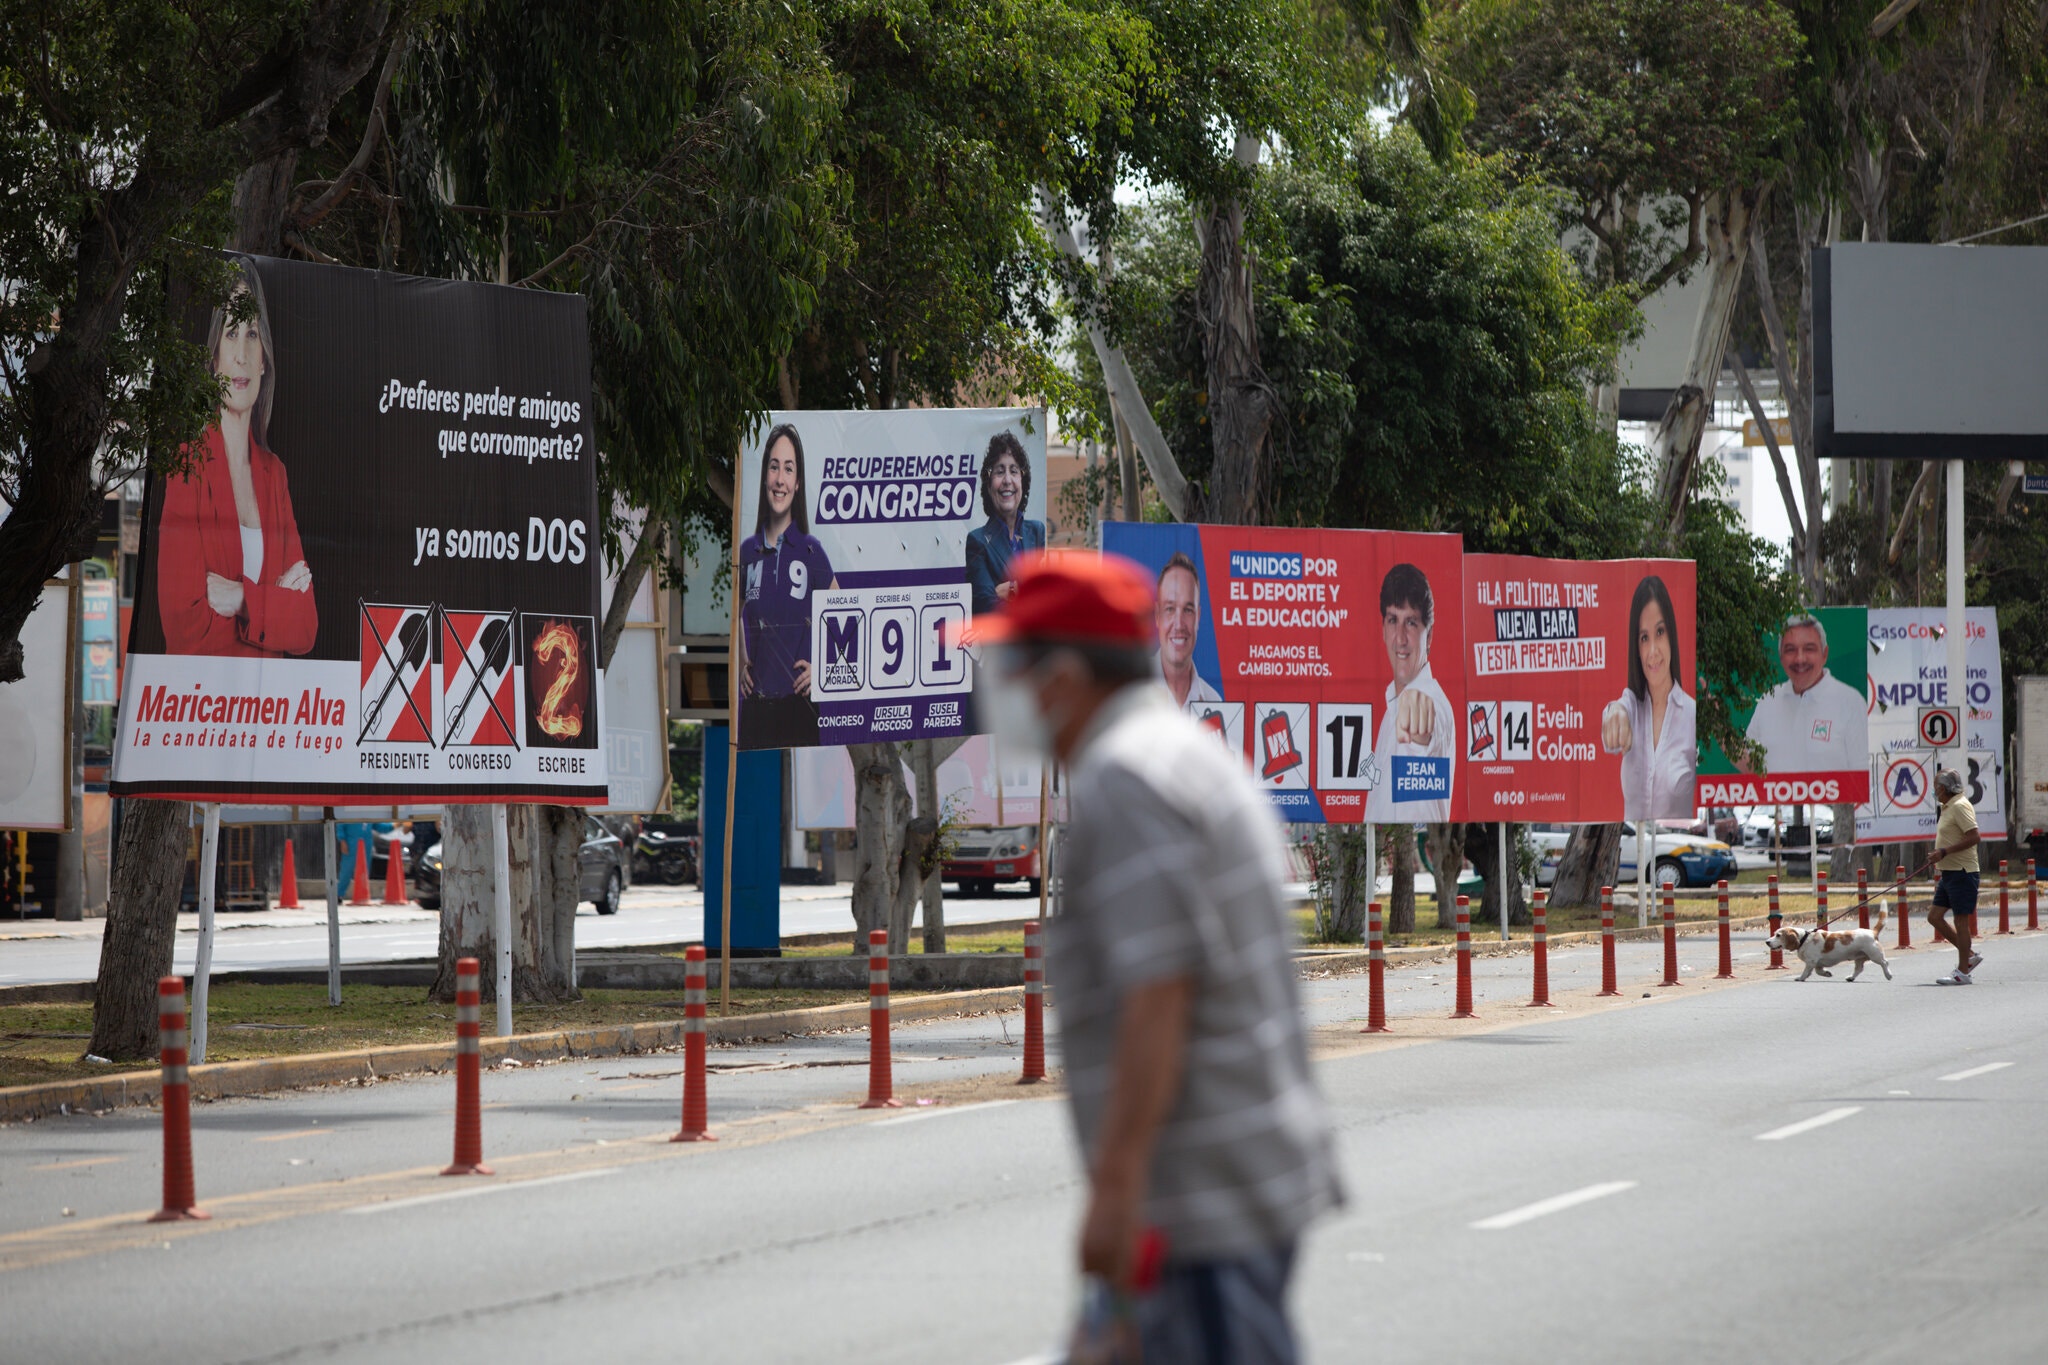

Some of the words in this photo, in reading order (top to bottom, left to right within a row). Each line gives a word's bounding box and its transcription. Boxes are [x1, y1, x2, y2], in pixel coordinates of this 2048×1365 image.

[379, 379, 460, 413] ¿Prefieres
[463, 386, 516, 421] perder
[519, 392, 581, 428] amigos
[438, 429, 467, 459] que
[470, 432, 583, 465] corromperte?
[823, 455, 954, 479] RECUPEREMOS
[958, 454, 978, 476] EL
[819, 481, 973, 520] CONGRESO
[413, 527, 440, 567] ya
[445, 529, 520, 560] somos
[526, 517, 586, 564] DOS
[1232, 555, 1300, 576] “UNIDOS
[1304, 558, 1338, 577] POR
[789, 560, 808, 600] 9
[827, 597, 847, 605] MARCA
[849, 595, 859, 604] ASÍ
[876, 594, 900, 603] ESCRIBE
[901, 592, 911, 602] ASÍ
[926, 592, 949, 601] ESCRIBE
[950, 590, 960, 600] ASÍ
[1230, 581, 1249, 600] EL
[1252, 582, 1326, 602] DEPORTE
[1329, 584, 1340, 602] Y
[1505, 578, 1560, 608] POLÍTICA
[1564, 583, 1599, 608] TIENE
[1222, 607, 1243, 626] LA
[1497, 611, 1537, 639] NUEVA
[1540, 610, 1577, 637] CARA
[827, 616, 858, 664] M
[882, 619, 904, 675] 9
[932, 617, 951, 671] 1
[1249, 645, 1305, 659] HAGAMOS
[1308, 646, 1322, 659] EL
[1477, 645, 1484, 672] Y
[1487, 641, 1517, 671] ESTÁ
[1521, 640, 1603, 669] PREPARADA!!
[826, 665, 858, 675] PARTIDO
[1238, 662, 1283, 675] CAMBIO
[1285, 663, 1332, 677] JUNTOS.
[1919, 665, 1987, 679] Katine
[535, 624, 582, 738] 2
[826, 675, 858, 685] MORADO
[136, 683, 289, 725] Maricarmen
[293, 687, 346, 726] Alva
[875, 707, 910, 719] URSULA
[930, 703, 957, 716] SUSEL
[817, 715, 864, 728] CONGRESO
[871, 719, 913, 732] MOSCOSO
[923, 716, 962, 729] PAREDES
[1537, 703, 1583, 729] Evelin
[133, 727, 151, 747] la
[162, 728, 257, 748] candidata
[267, 730, 285, 748] de
[295, 730, 343, 754] fuego
[1504, 712, 1530, 751] 14
[1326, 715, 1363, 778] 17
[1537, 735, 1596, 761] Coloma
[1890, 740, 1919, 749] MARC
[360, 752, 430, 770] PRESIDENTE
[448, 754, 512, 770] CONGRESO
[538, 757, 586, 774] ESCRIBE
[1406, 762, 1436, 775] JEAN
[1482, 766, 1514, 774] CONGRESISTA
[1398, 777, 1446, 790] FERRARI
[1894, 767, 1919, 796] A
[1258, 795, 1310, 806] NGRESISTA
[1325, 795, 1361, 806] ESCRIBE
[1700, 783, 1759, 804] PARA
[1763, 780, 1840, 802] TODOS
